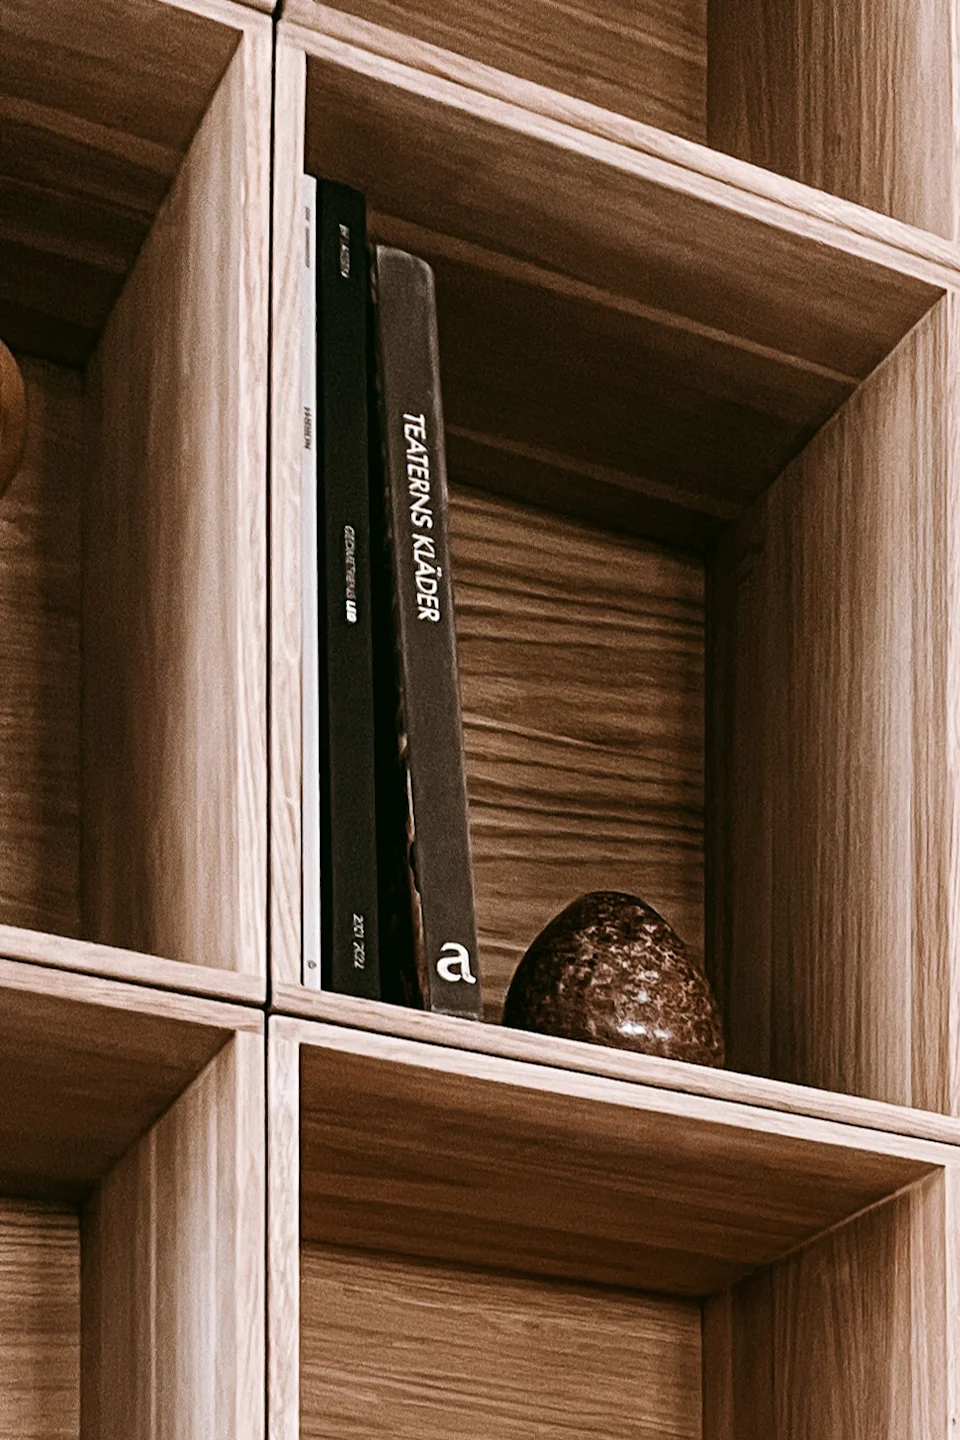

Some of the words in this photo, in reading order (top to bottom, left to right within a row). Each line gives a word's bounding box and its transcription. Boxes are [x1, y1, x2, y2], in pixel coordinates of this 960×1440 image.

[403, 413, 433, 529] TEATERNS
[412, 533, 441, 623] KLÄDER
[437, 942, 477, 984] a
